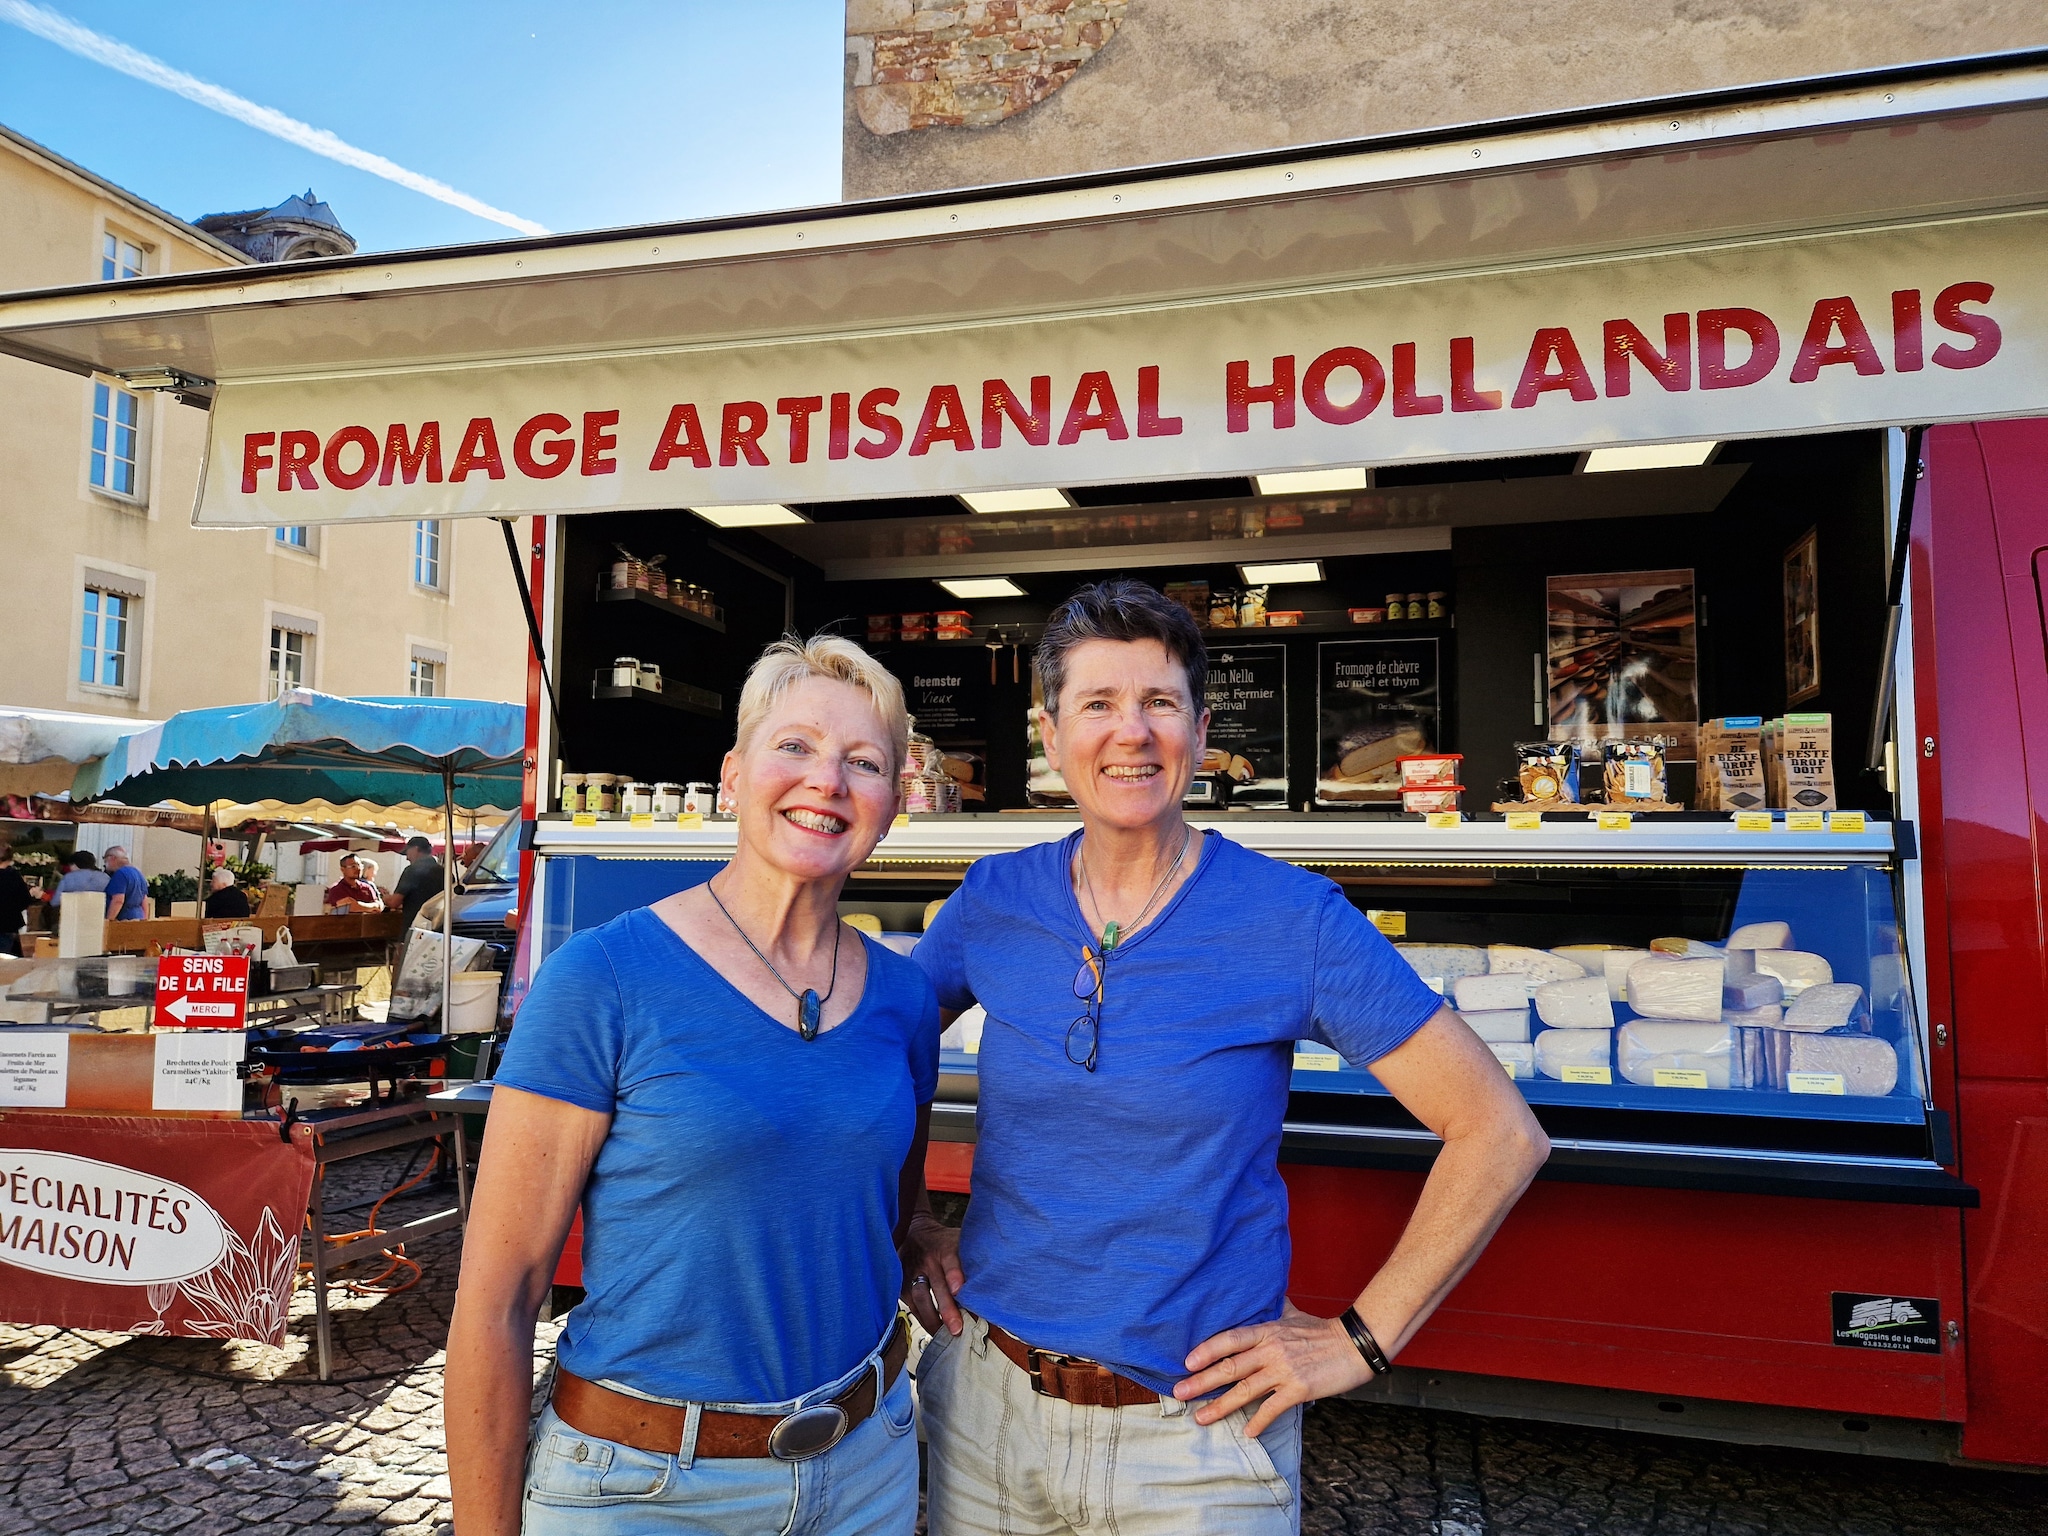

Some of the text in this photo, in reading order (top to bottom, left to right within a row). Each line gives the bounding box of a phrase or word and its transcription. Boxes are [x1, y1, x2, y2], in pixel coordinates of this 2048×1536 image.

[241, 281, 2002, 493] FROMAGE ARTISANAL HOLLANDAIS
[1335, 659, 1420, 678] Fromage de chèvre
[913, 675, 961, 688] Beemster
[1229, 668, 1254, 683] Nella
[1336, 677, 1420, 689] au miel et thym
[922, 690, 953, 704] Vieux
[1233, 688, 1275, 699] Fermier
[1211, 699, 1247, 711] estival
[1730, 745, 1746, 753] DE
[1800, 741, 1817, 750] DE
[1717, 753, 1759, 762] BESTE
[1786, 750, 1830, 759] BESTE
[1722, 760, 1756, 769] DROP
[1791, 758, 1826, 767] DROP
[182, 957, 224, 974] SENS
[158, 975, 245, 992] DE LA FILE
[191, 1005, 221, 1014] MERCI
[1836, 1329, 1937, 1345] Les Magasins de la Route
